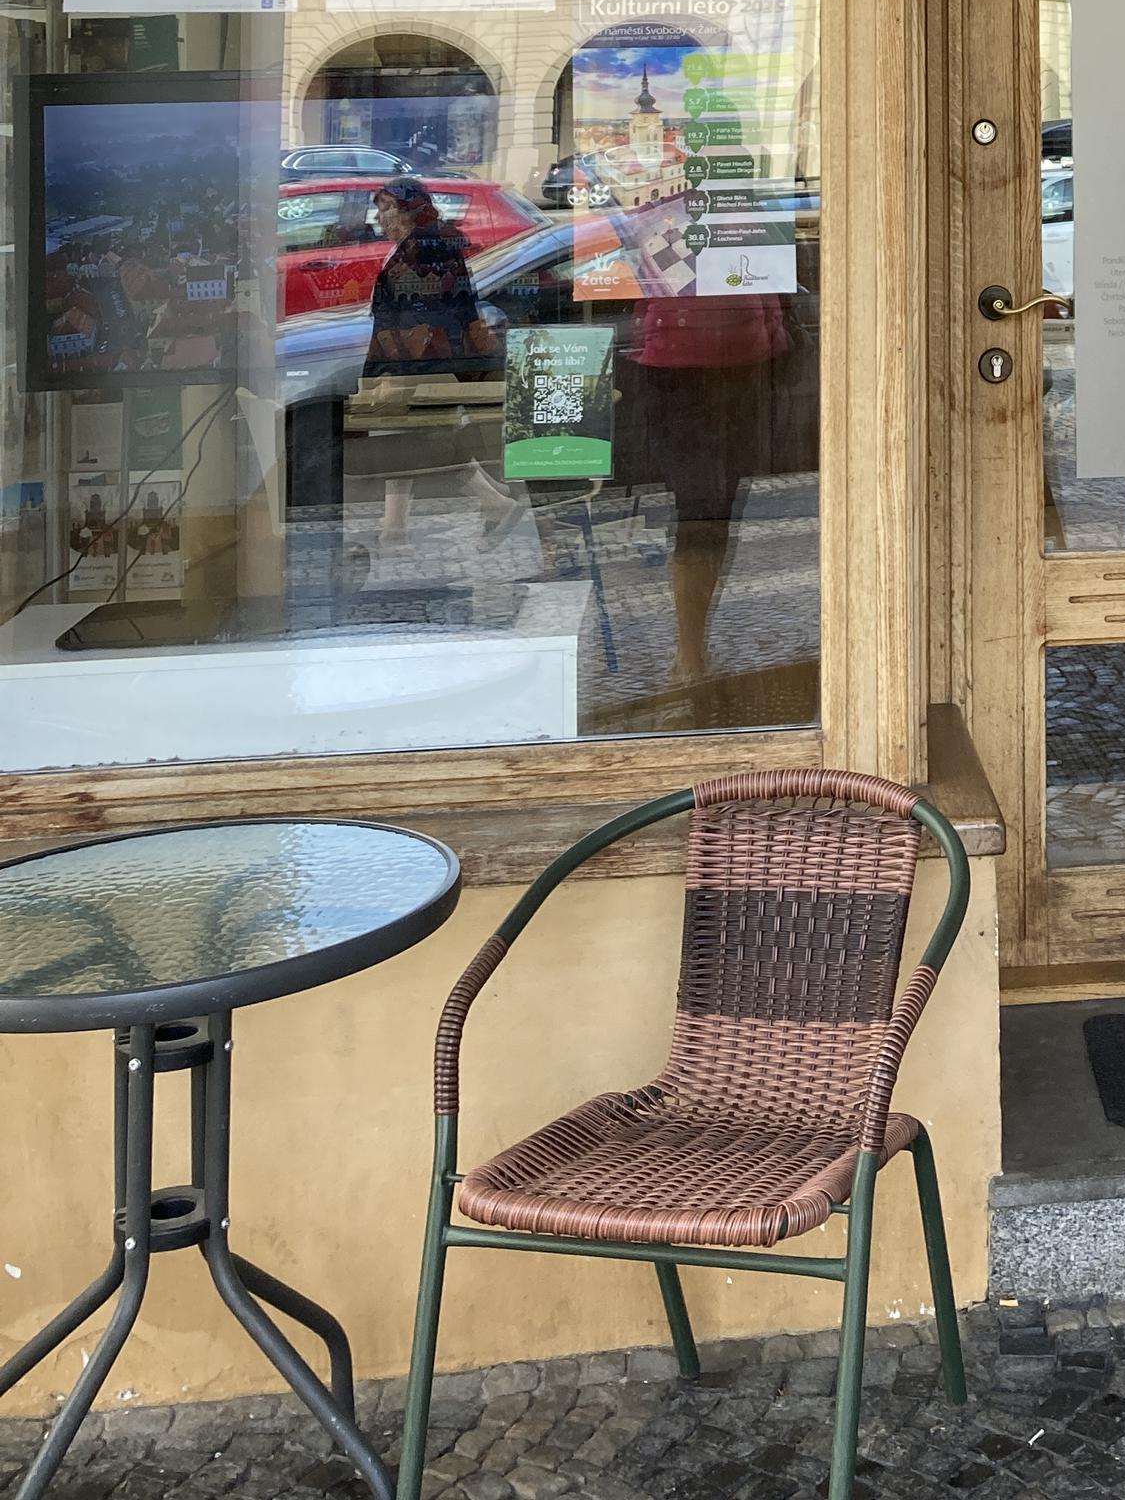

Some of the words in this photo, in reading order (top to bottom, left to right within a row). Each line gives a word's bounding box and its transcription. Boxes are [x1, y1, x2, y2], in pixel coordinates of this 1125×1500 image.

[645, 25, 687, 37] Svobody
[527, 343, 546, 356] Jak
[550, 346, 561, 354] se
[564, 343, 588, 354] Vám
[544, 357, 563, 366] nás
